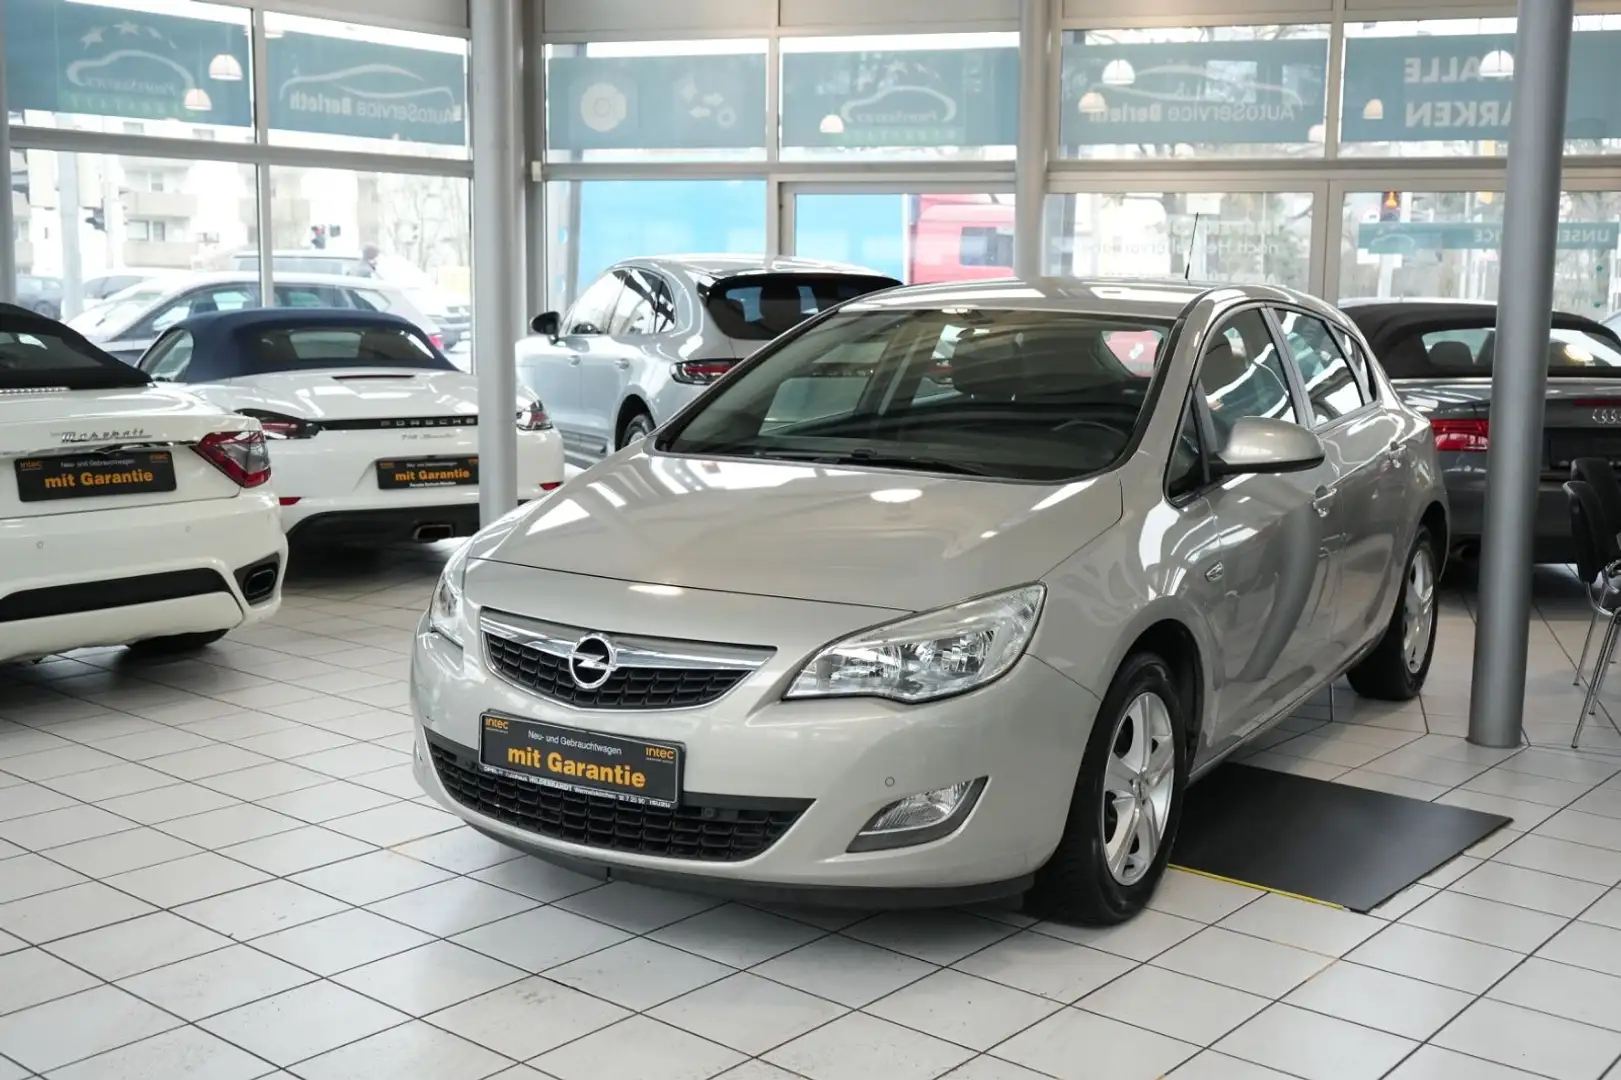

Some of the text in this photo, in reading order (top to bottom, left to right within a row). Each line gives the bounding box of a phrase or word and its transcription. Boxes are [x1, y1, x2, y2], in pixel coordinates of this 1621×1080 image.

[381, 418, 475, 427] PORSCHE
[44, 469, 154, 489] mit Garantie
[395, 469, 470, 481] mit Garantie
[485, 718, 509, 731] intec
[528, 730, 622, 756] Neu- und Gebrauchtwagen
[645, 747, 674, 760] intec
[507, 746, 646, 788] mit Garantie
